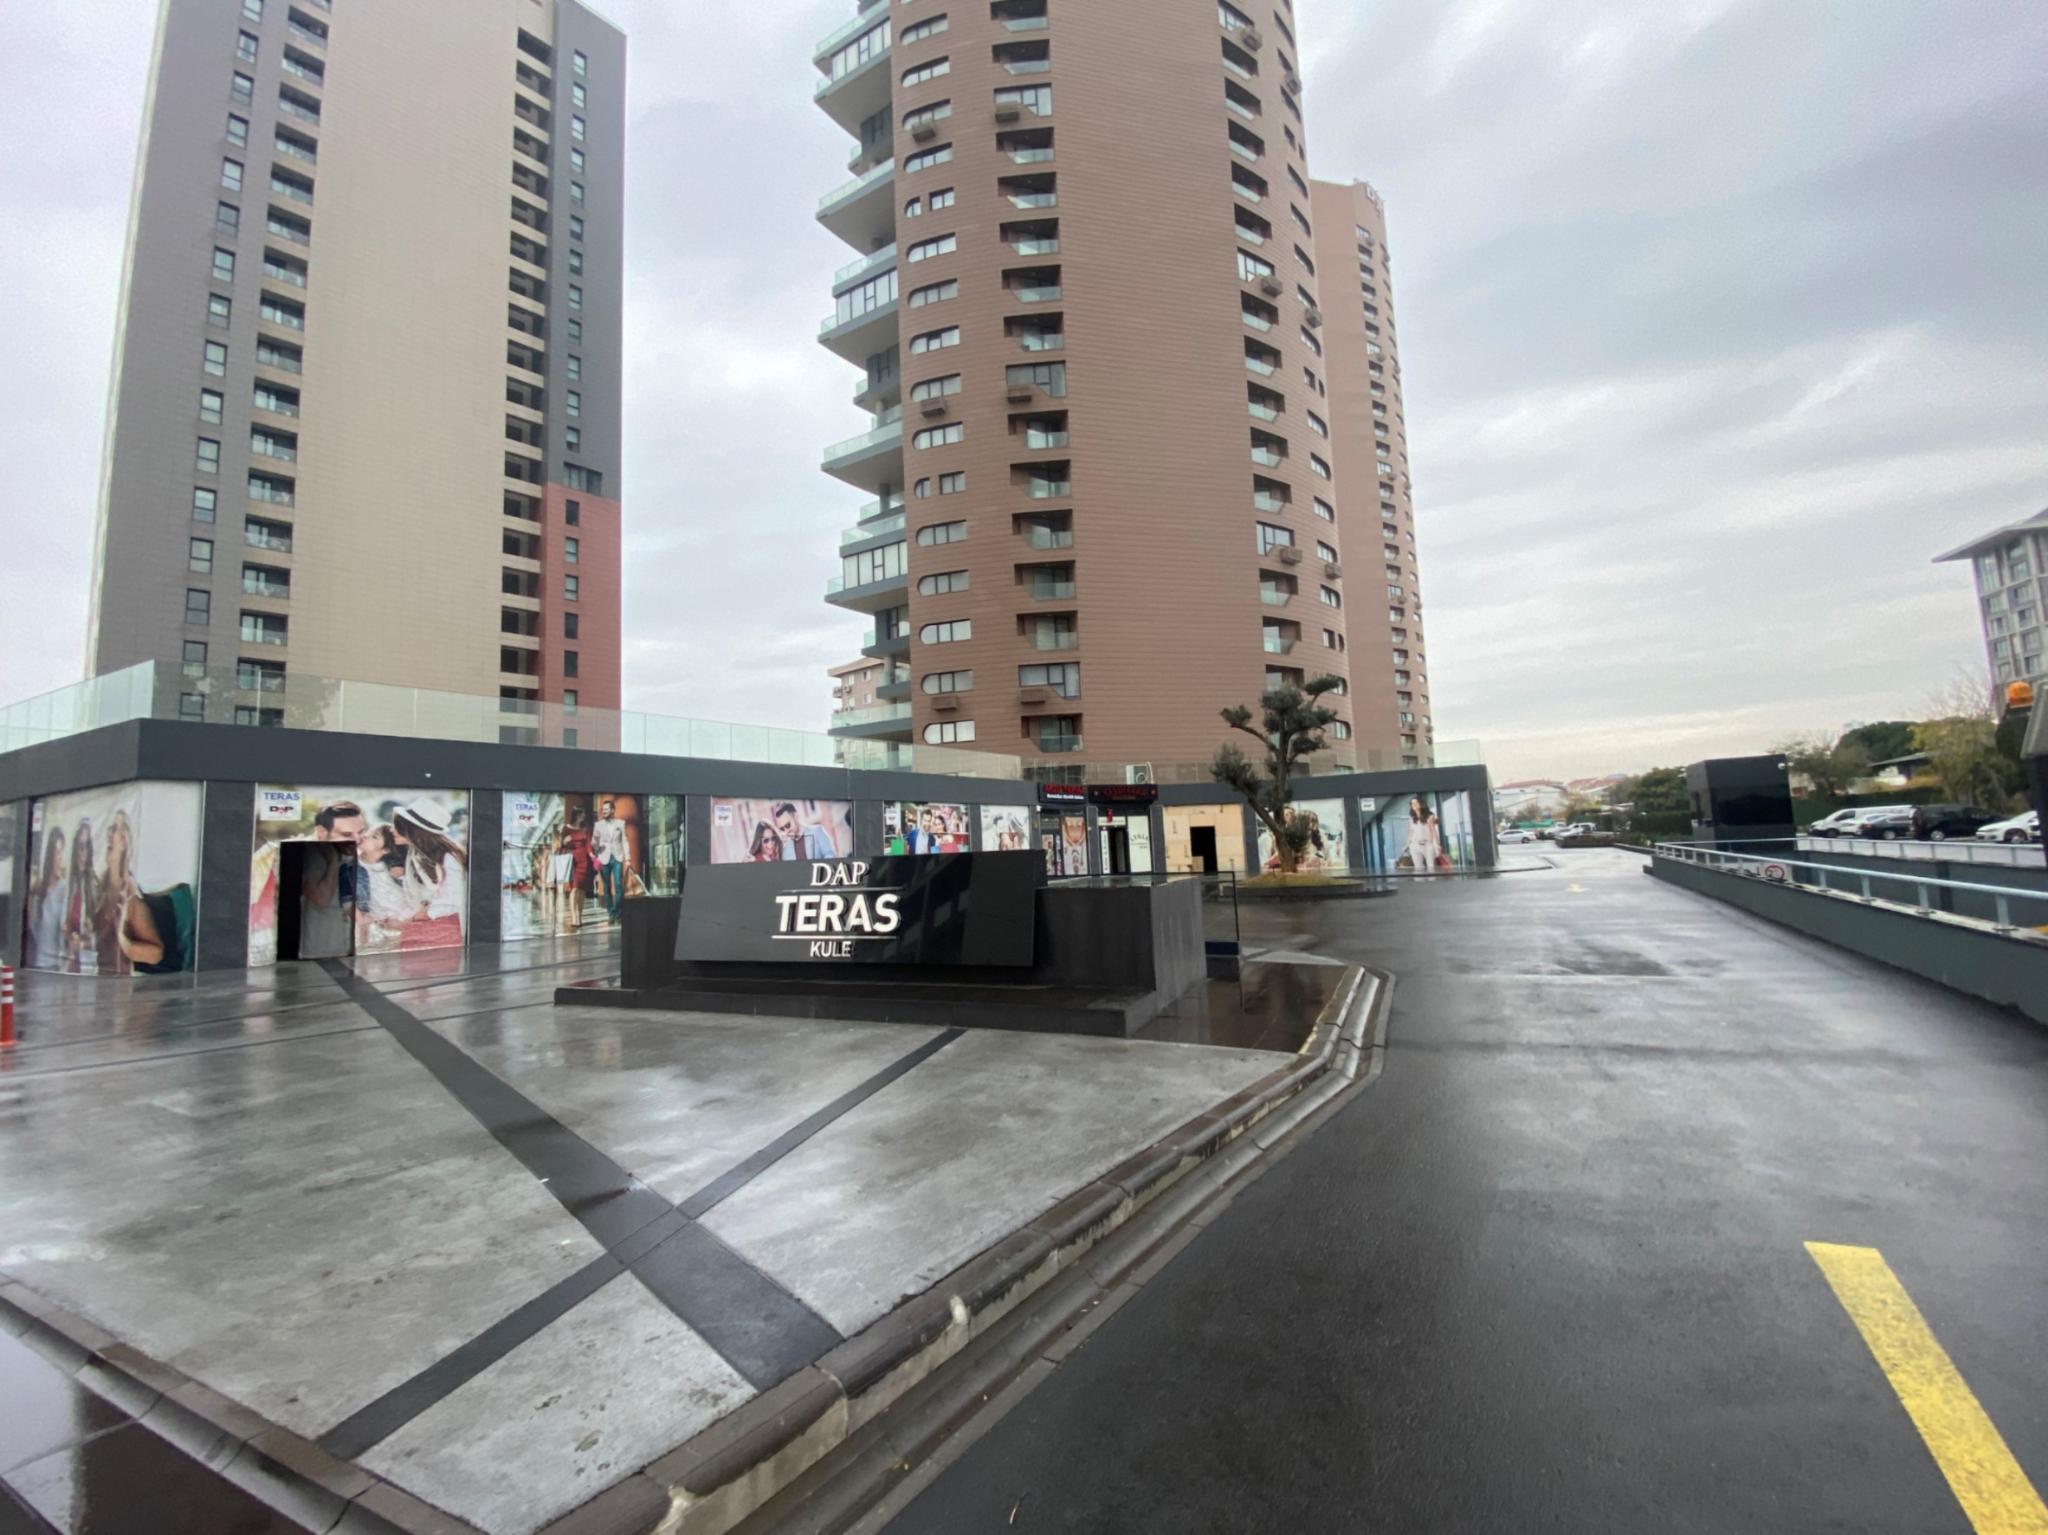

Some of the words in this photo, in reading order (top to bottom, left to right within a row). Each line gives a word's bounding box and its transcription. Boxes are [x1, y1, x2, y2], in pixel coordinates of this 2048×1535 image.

[263, 792, 301, 801] TERAS
[810, 861, 867, 887] DAP
[775, 893, 900, 933] TERAS
[809, 940, 852, 958] KULE
